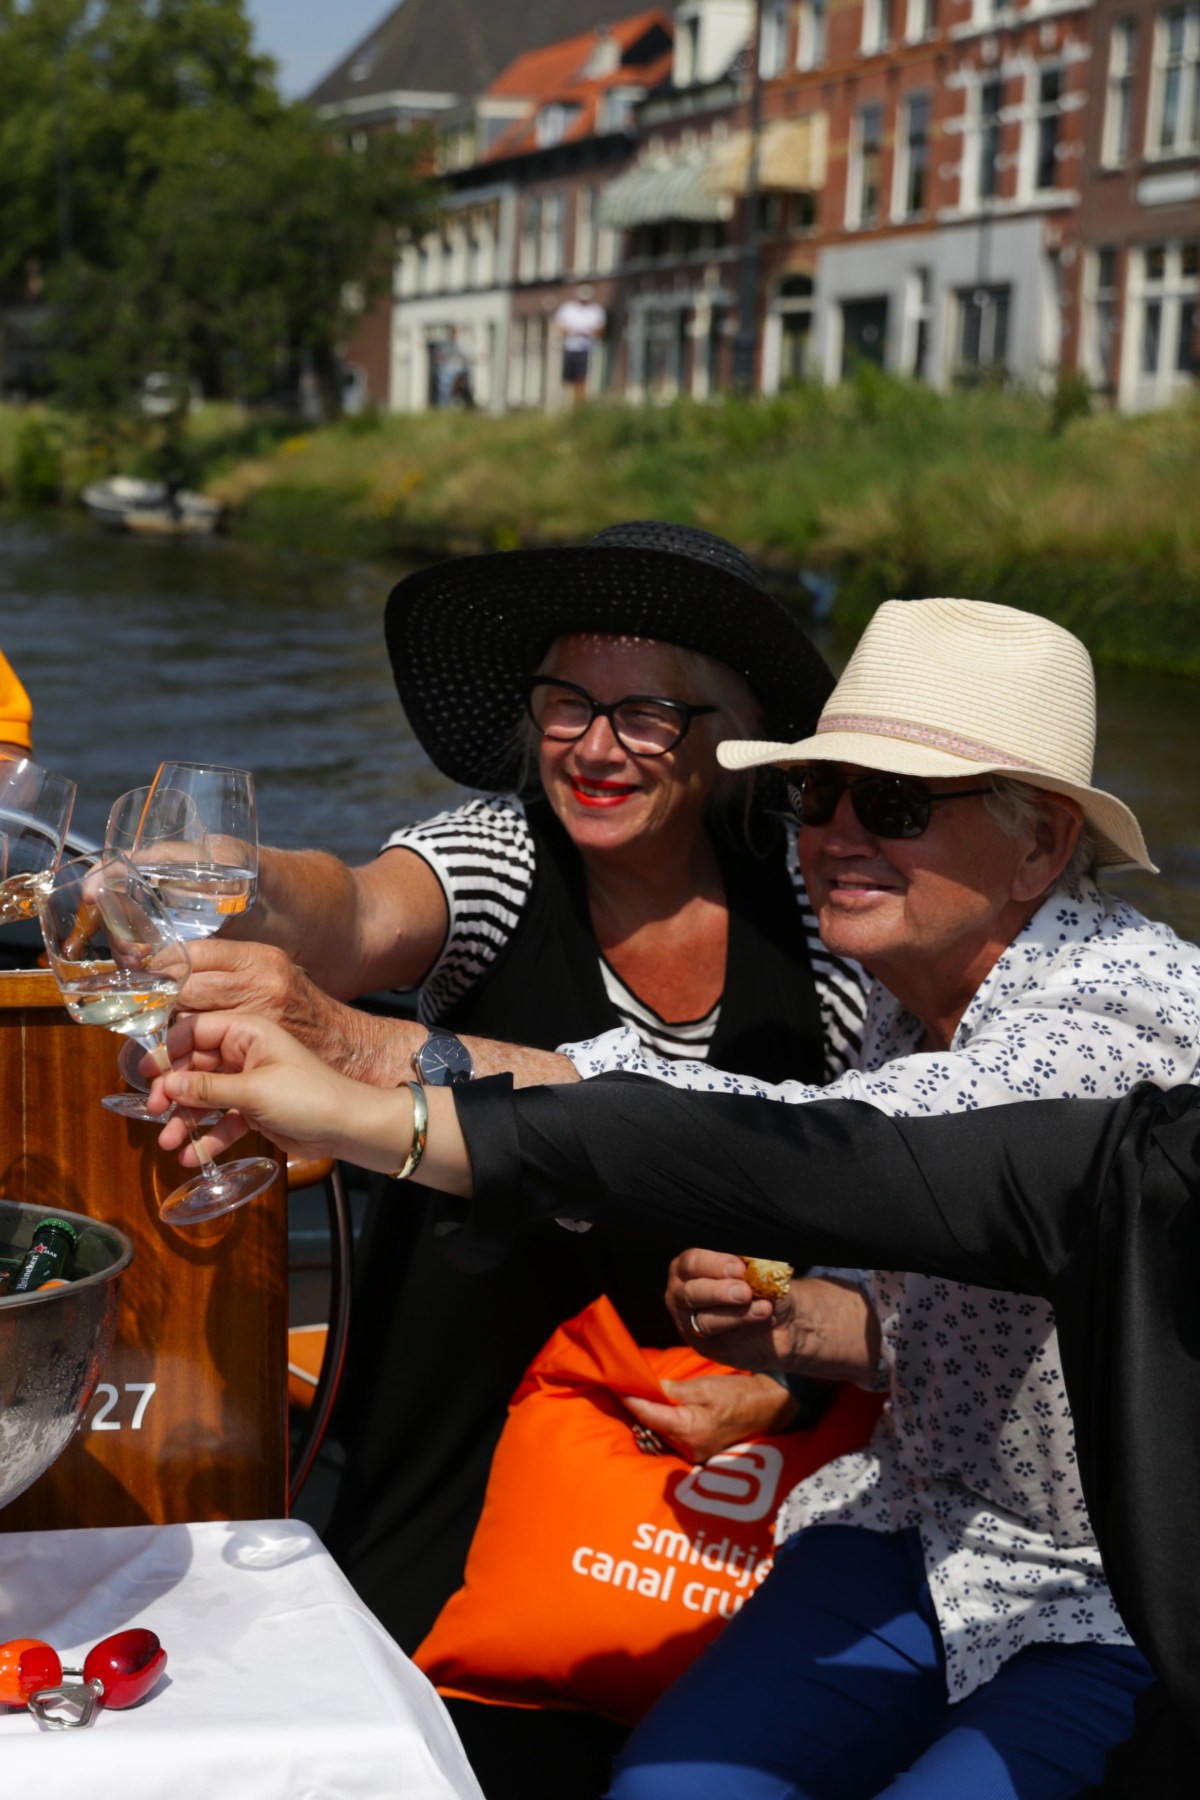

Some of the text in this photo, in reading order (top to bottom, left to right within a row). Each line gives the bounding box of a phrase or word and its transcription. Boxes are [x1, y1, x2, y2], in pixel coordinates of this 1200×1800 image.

[15, 1254, 40, 1291] Heineken
[77, 1382, 157, 1431] 27
[571, 1546, 755, 1620] canal cru
[632, 1522, 774, 1588] smidtje
